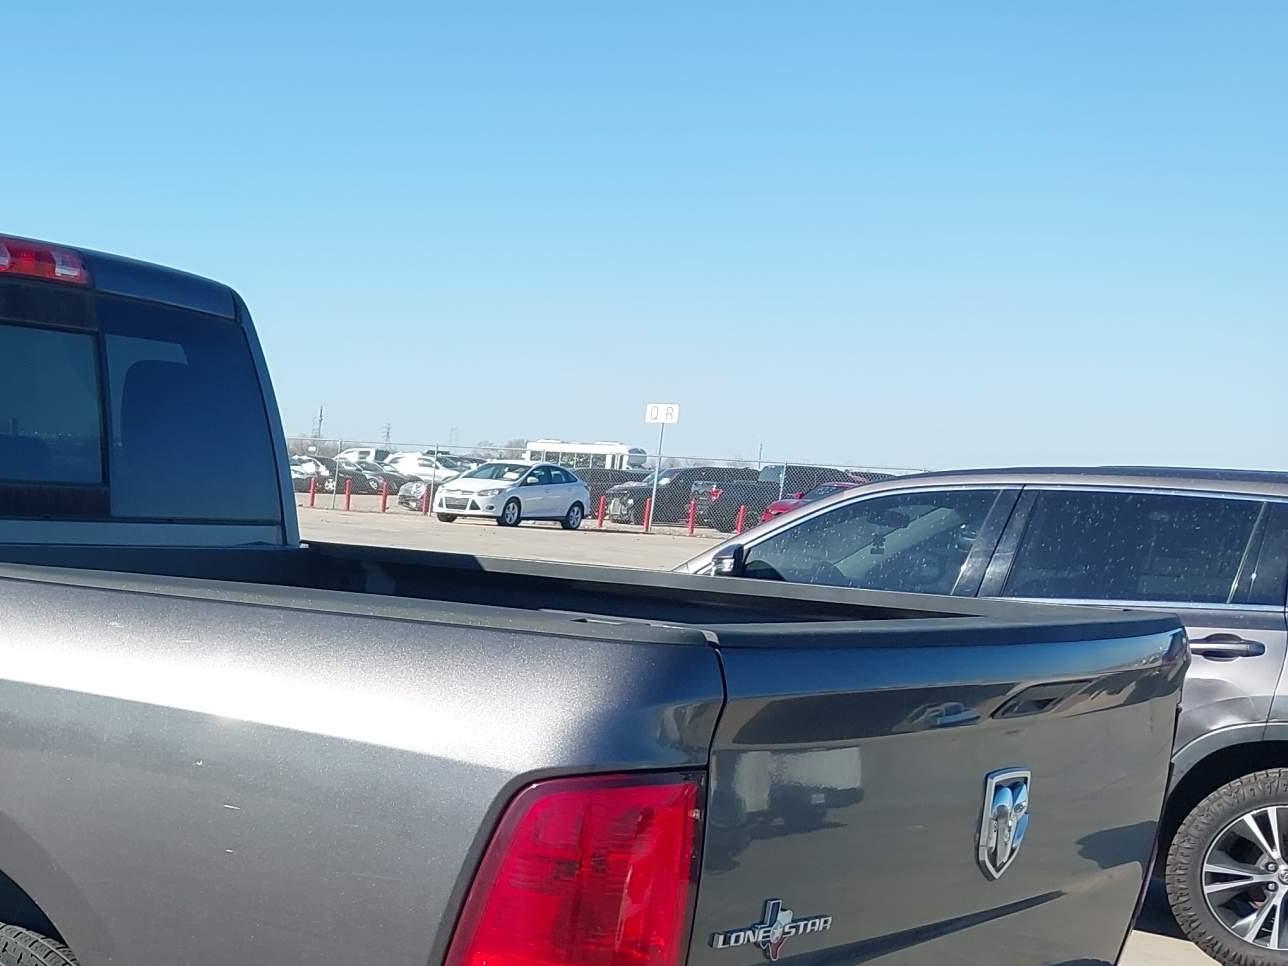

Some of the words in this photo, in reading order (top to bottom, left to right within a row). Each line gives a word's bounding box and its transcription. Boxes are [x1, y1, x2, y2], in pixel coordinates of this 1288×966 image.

[650, 405, 659, 420] Q
[665, 406, 674, 420] R
[716, 927, 772, 949] LONE
[782, 916, 832, 938] STAR
